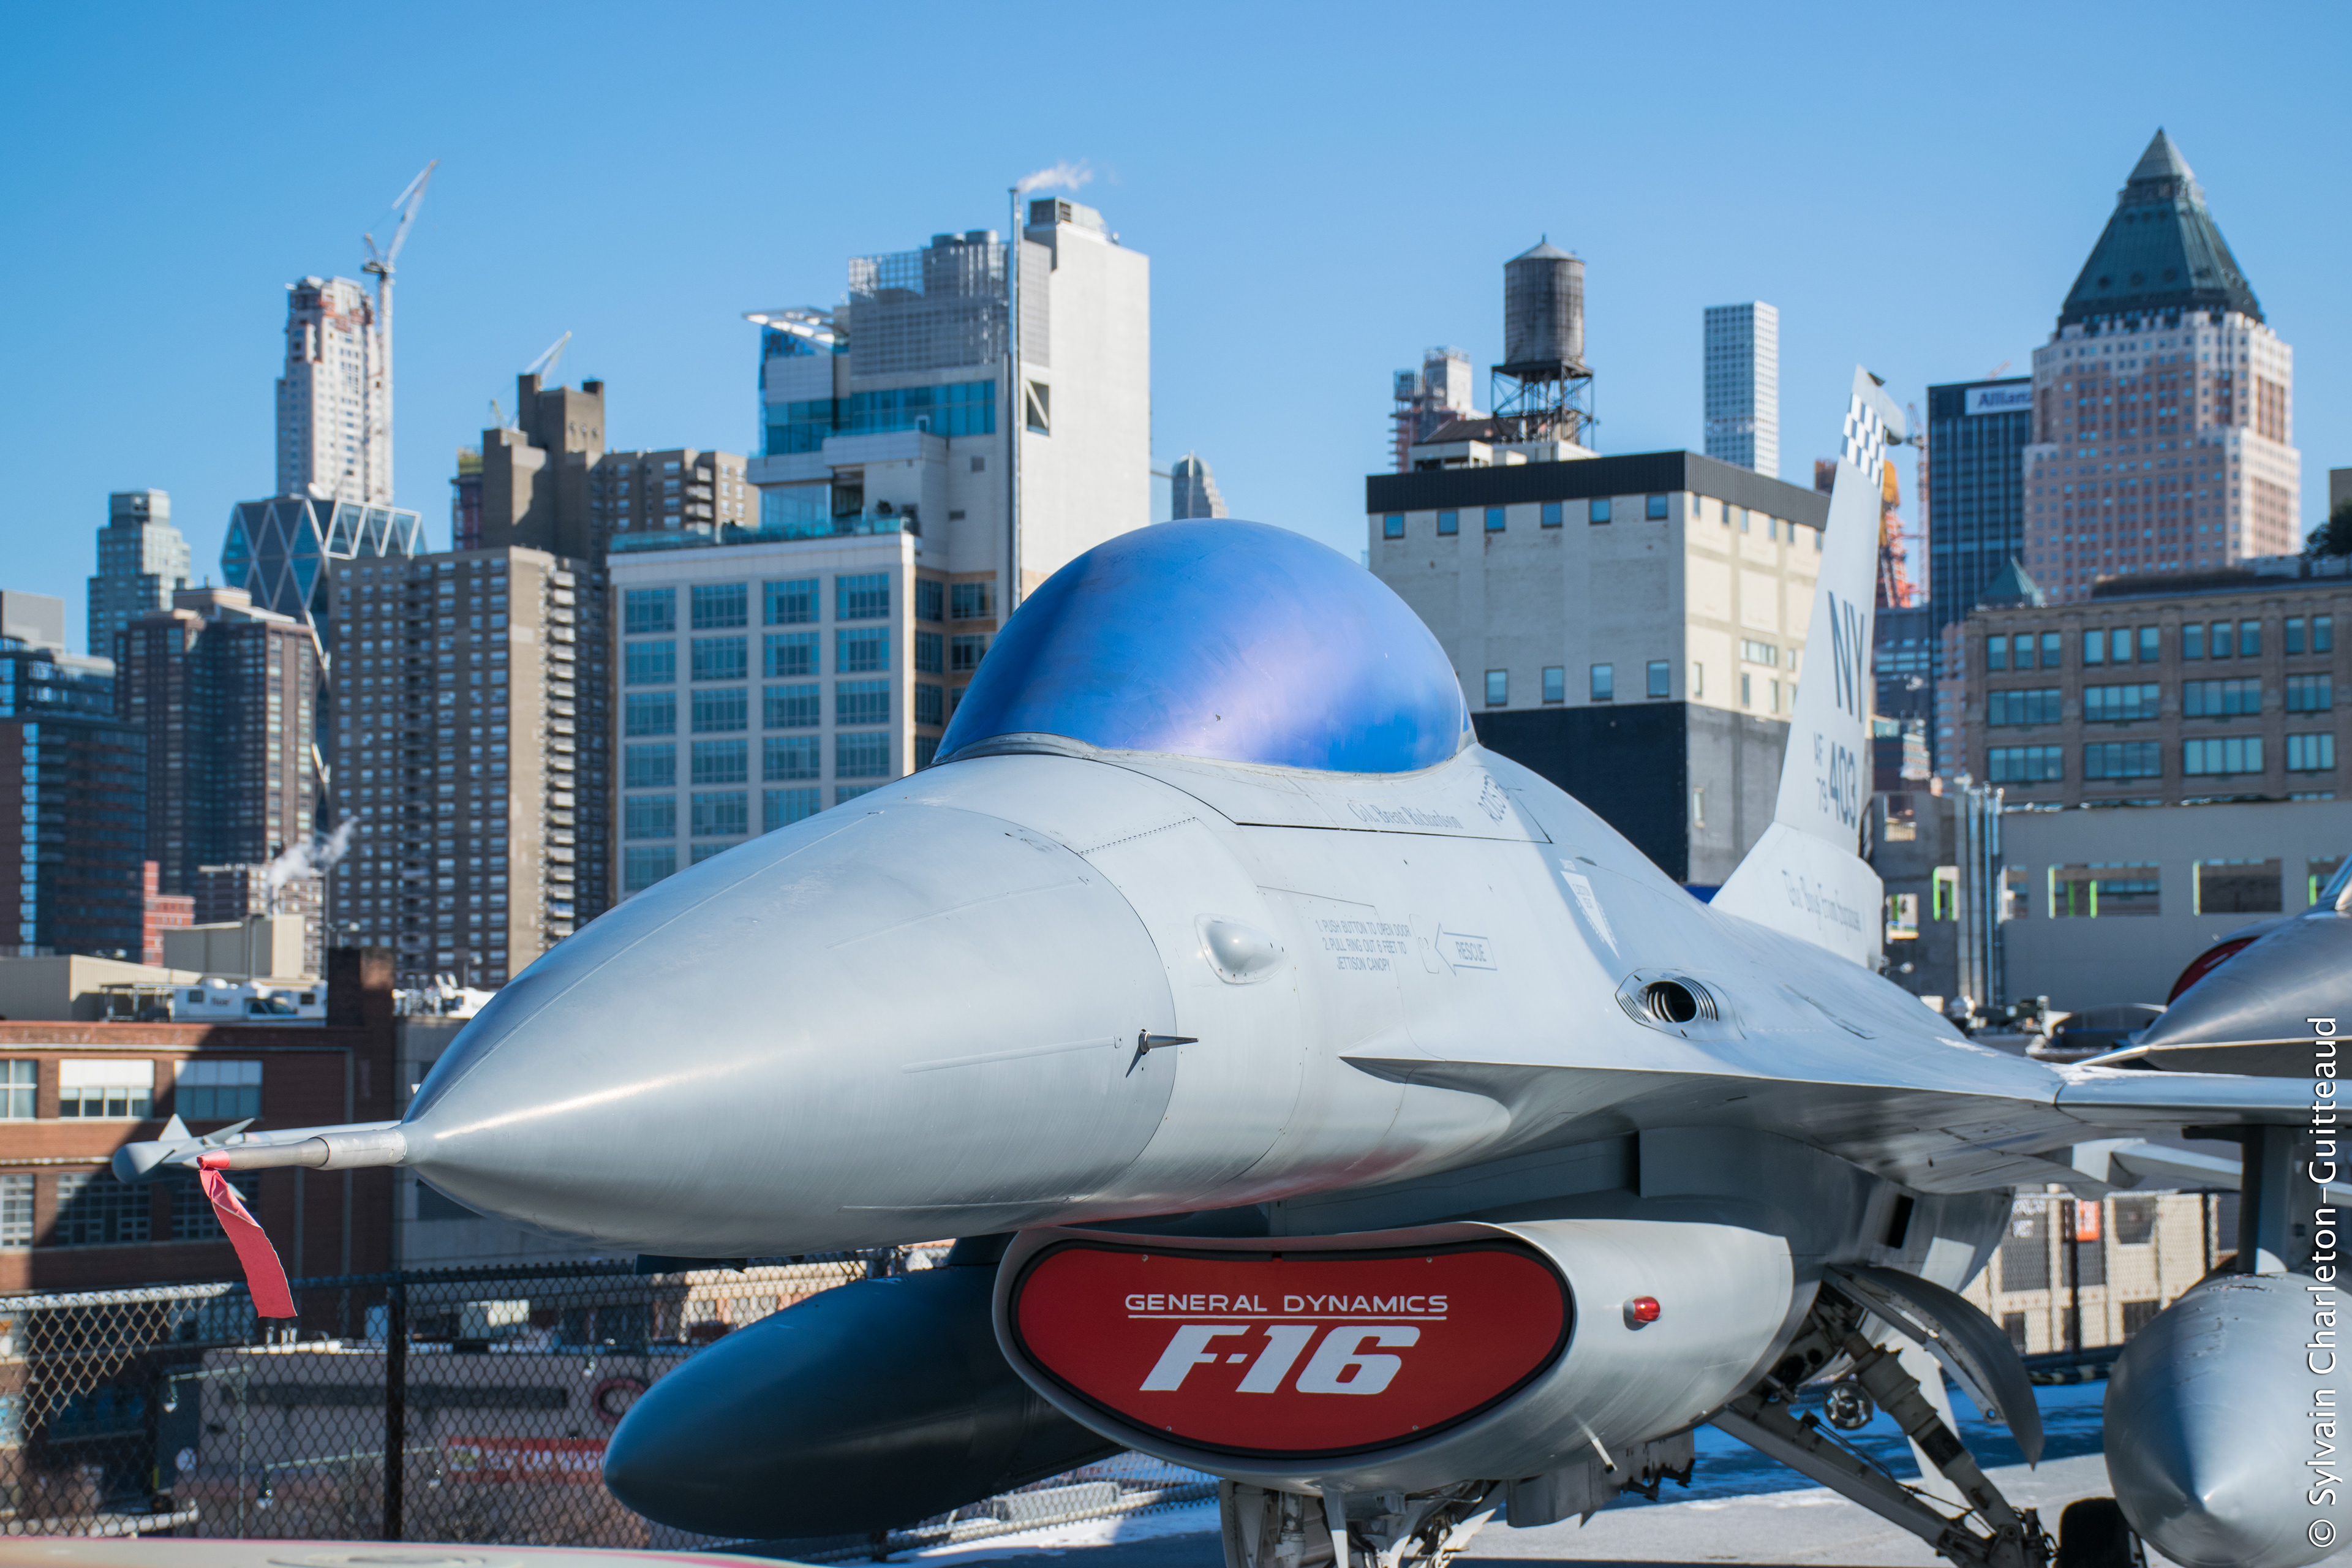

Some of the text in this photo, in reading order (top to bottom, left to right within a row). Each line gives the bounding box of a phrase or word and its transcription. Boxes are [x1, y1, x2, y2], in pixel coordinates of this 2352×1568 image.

[1828, 590, 1864, 724] NY
[1813, 731, 1823, 767] AF
[1477, 774, 1510, 827] ROOSTER
[1815, 776, 1828, 814] 79
[1829, 741, 1856, 831] 403
[1347, 803, 1464, 829] Col. Brent Richardson
[1316, 919, 1411, 937] 1. PUSH BUTTON TO OPEN DOOR
[1329, 938, 1347, 951] PULL
[1346, 938, 1363, 952] RING
[1363, 939, 1376, 952] OUT
[1376, 940, 1382, 953] 6
[1382, 940, 1397, 954] FEET
[1397, 941, 1407, 955] TO
[1455, 941, 1487, 962] RESCUE
[1336, 956, 1390, 971] JETTISON CANOPY
[1125, 1294, 1448, 1313] GENERAL DYNAMICS
[1139, 1324, 1420, 1395] F-16
